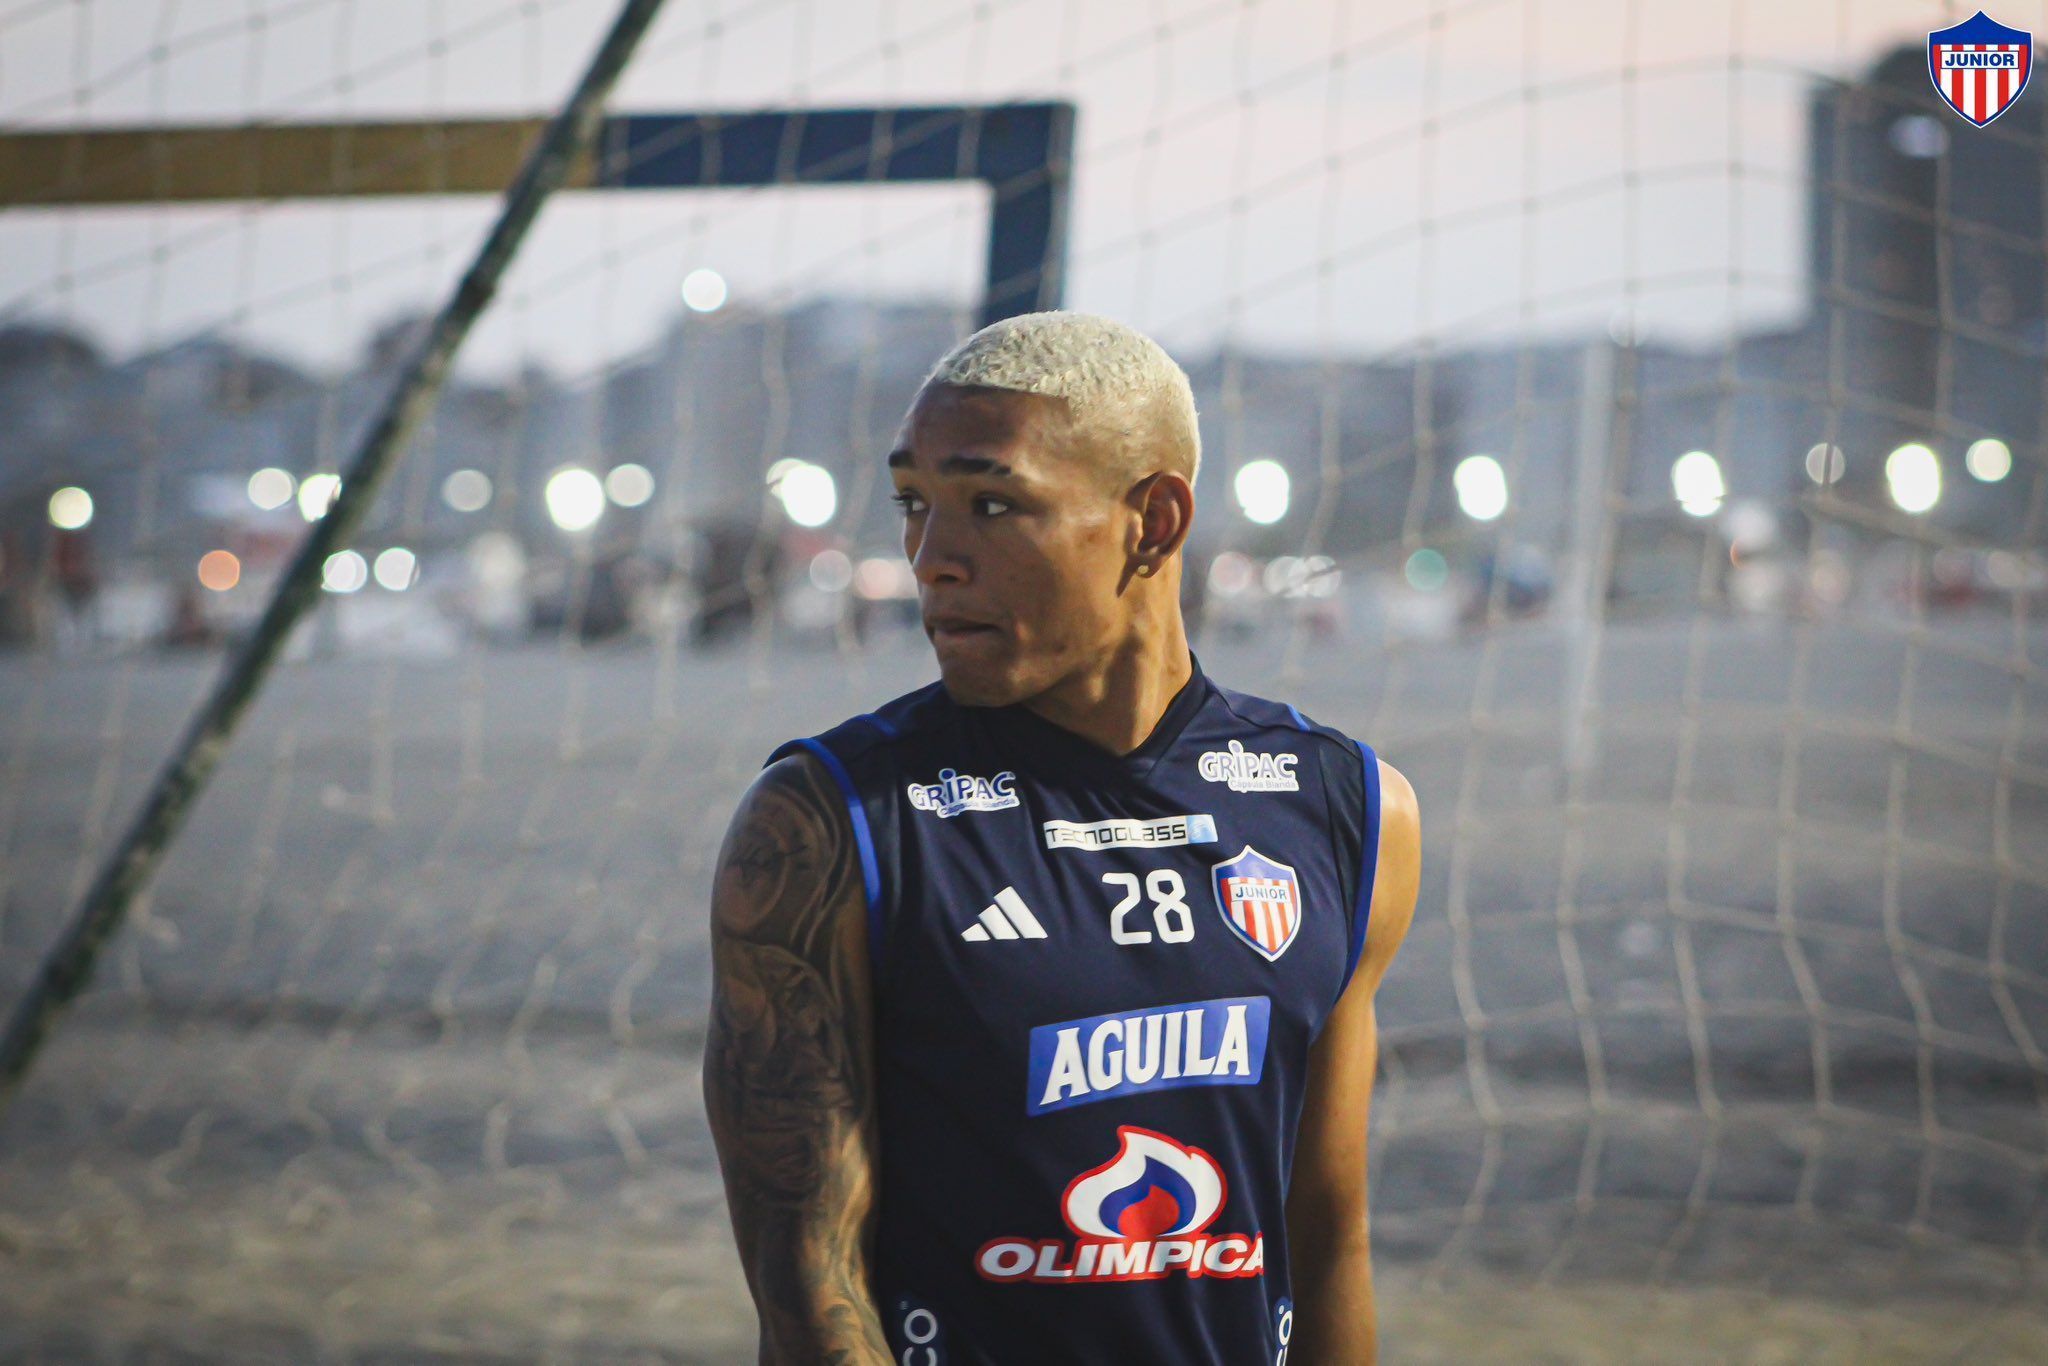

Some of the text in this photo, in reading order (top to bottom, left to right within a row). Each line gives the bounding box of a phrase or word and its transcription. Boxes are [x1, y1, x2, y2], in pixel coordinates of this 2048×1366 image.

[1102, 869, 1195, 945] 28
[1235, 886, 1288, 901] JUNIOR
[1039, 1004, 1251, 1106] AGUILA
